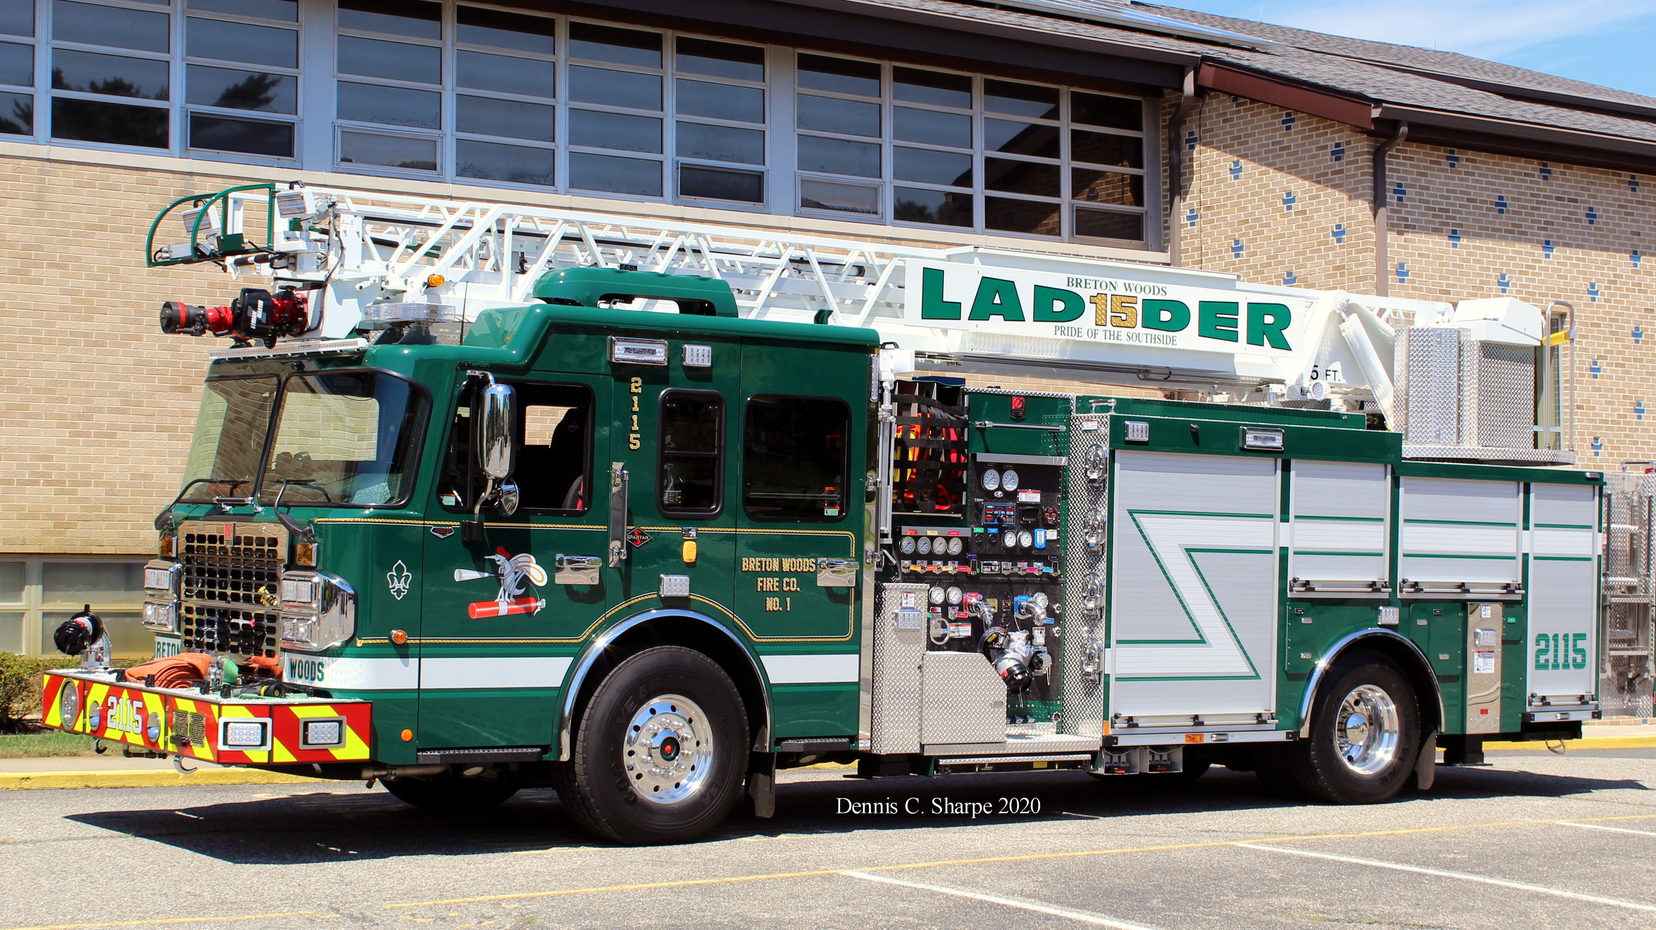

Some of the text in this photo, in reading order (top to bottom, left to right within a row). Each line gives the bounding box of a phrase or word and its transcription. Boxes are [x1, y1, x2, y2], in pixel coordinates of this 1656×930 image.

[1066, 276, 1168, 297] BRETON WOODS
[1054, 325, 1178, 346] PRIDE OF THE SOUTHSIDE
[1325, 369, 1341, 382] FT.
[628, 376, 643, 451] 2115
[741, 557, 816, 573] BRETON WOODS
[756, 577, 800, 592] FIRE CO.
[765, 597, 791, 612] NO. 1
[1534, 632, 1587, 671] 2115
[290, 658, 325, 682] WOODS
[107, 695, 143, 735] 2115
